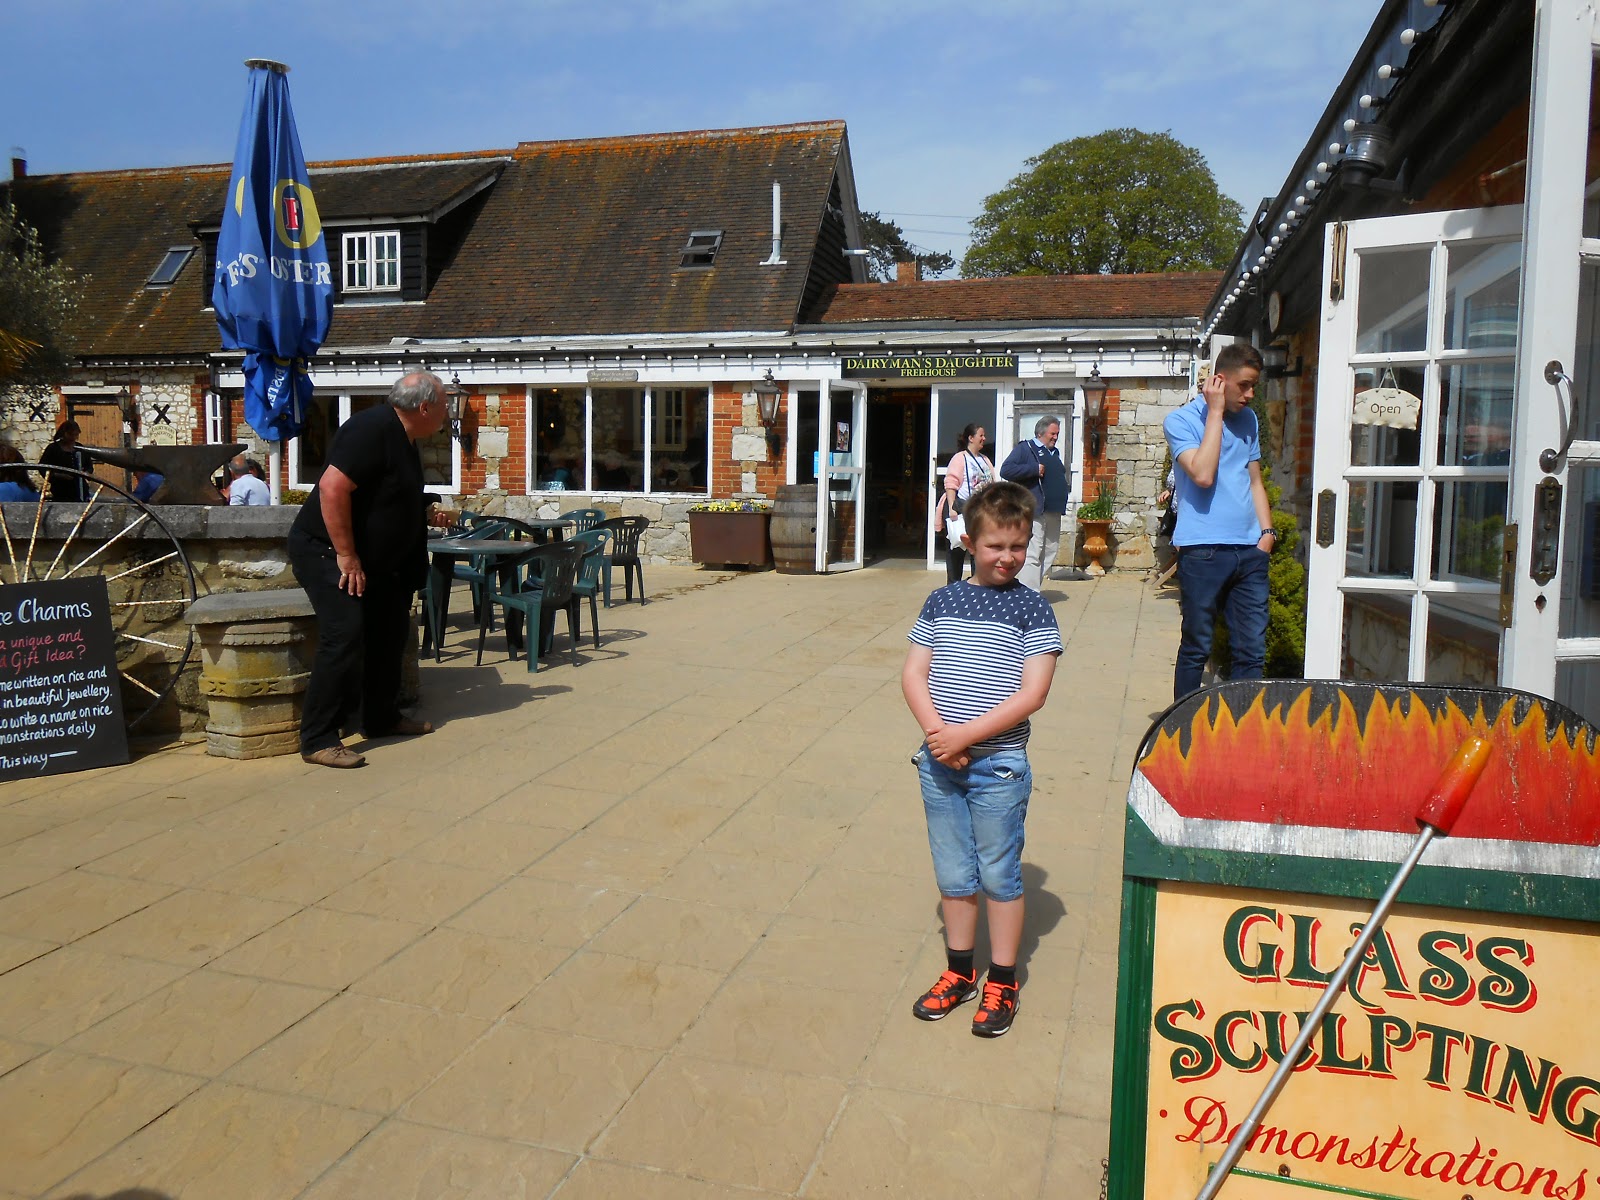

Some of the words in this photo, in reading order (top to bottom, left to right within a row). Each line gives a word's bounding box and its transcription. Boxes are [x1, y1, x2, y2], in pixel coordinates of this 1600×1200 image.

[846, 357, 932, 369] DAIRYMAN'S
[936, 356, 1014, 369] DAUGHTER
[900, 368, 957, 377] FREEHOUSE
[1370, 403, 1401, 417] Open
[18, 598, 92, 623] Charms
[11, 634, 53, 651] unique
[57, 629, 84, 642] and
[11, 651, 39, 675] Gift
[53, 673, 66, 684] on
[68, 670, 85, 682] rice
[87, 665, 107, 679] and
[3, 698, 14, 708] in
[15, 689, 63, 708] beautiful
[62, 684, 113, 708] jewellery.
[10, 711, 38, 728] write
[40, 713, 49, 725] a
[50, 709, 77, 723] name
[79, 707, 91, 718] on
[93, 705, 113, 716] rice
[68, 720, 96, 740] daily
[22, 753, 47, 771] way
[1223, 905, 1537, 1014] GLASS
[1153, 998, 1600, 1147] SCULPTING
